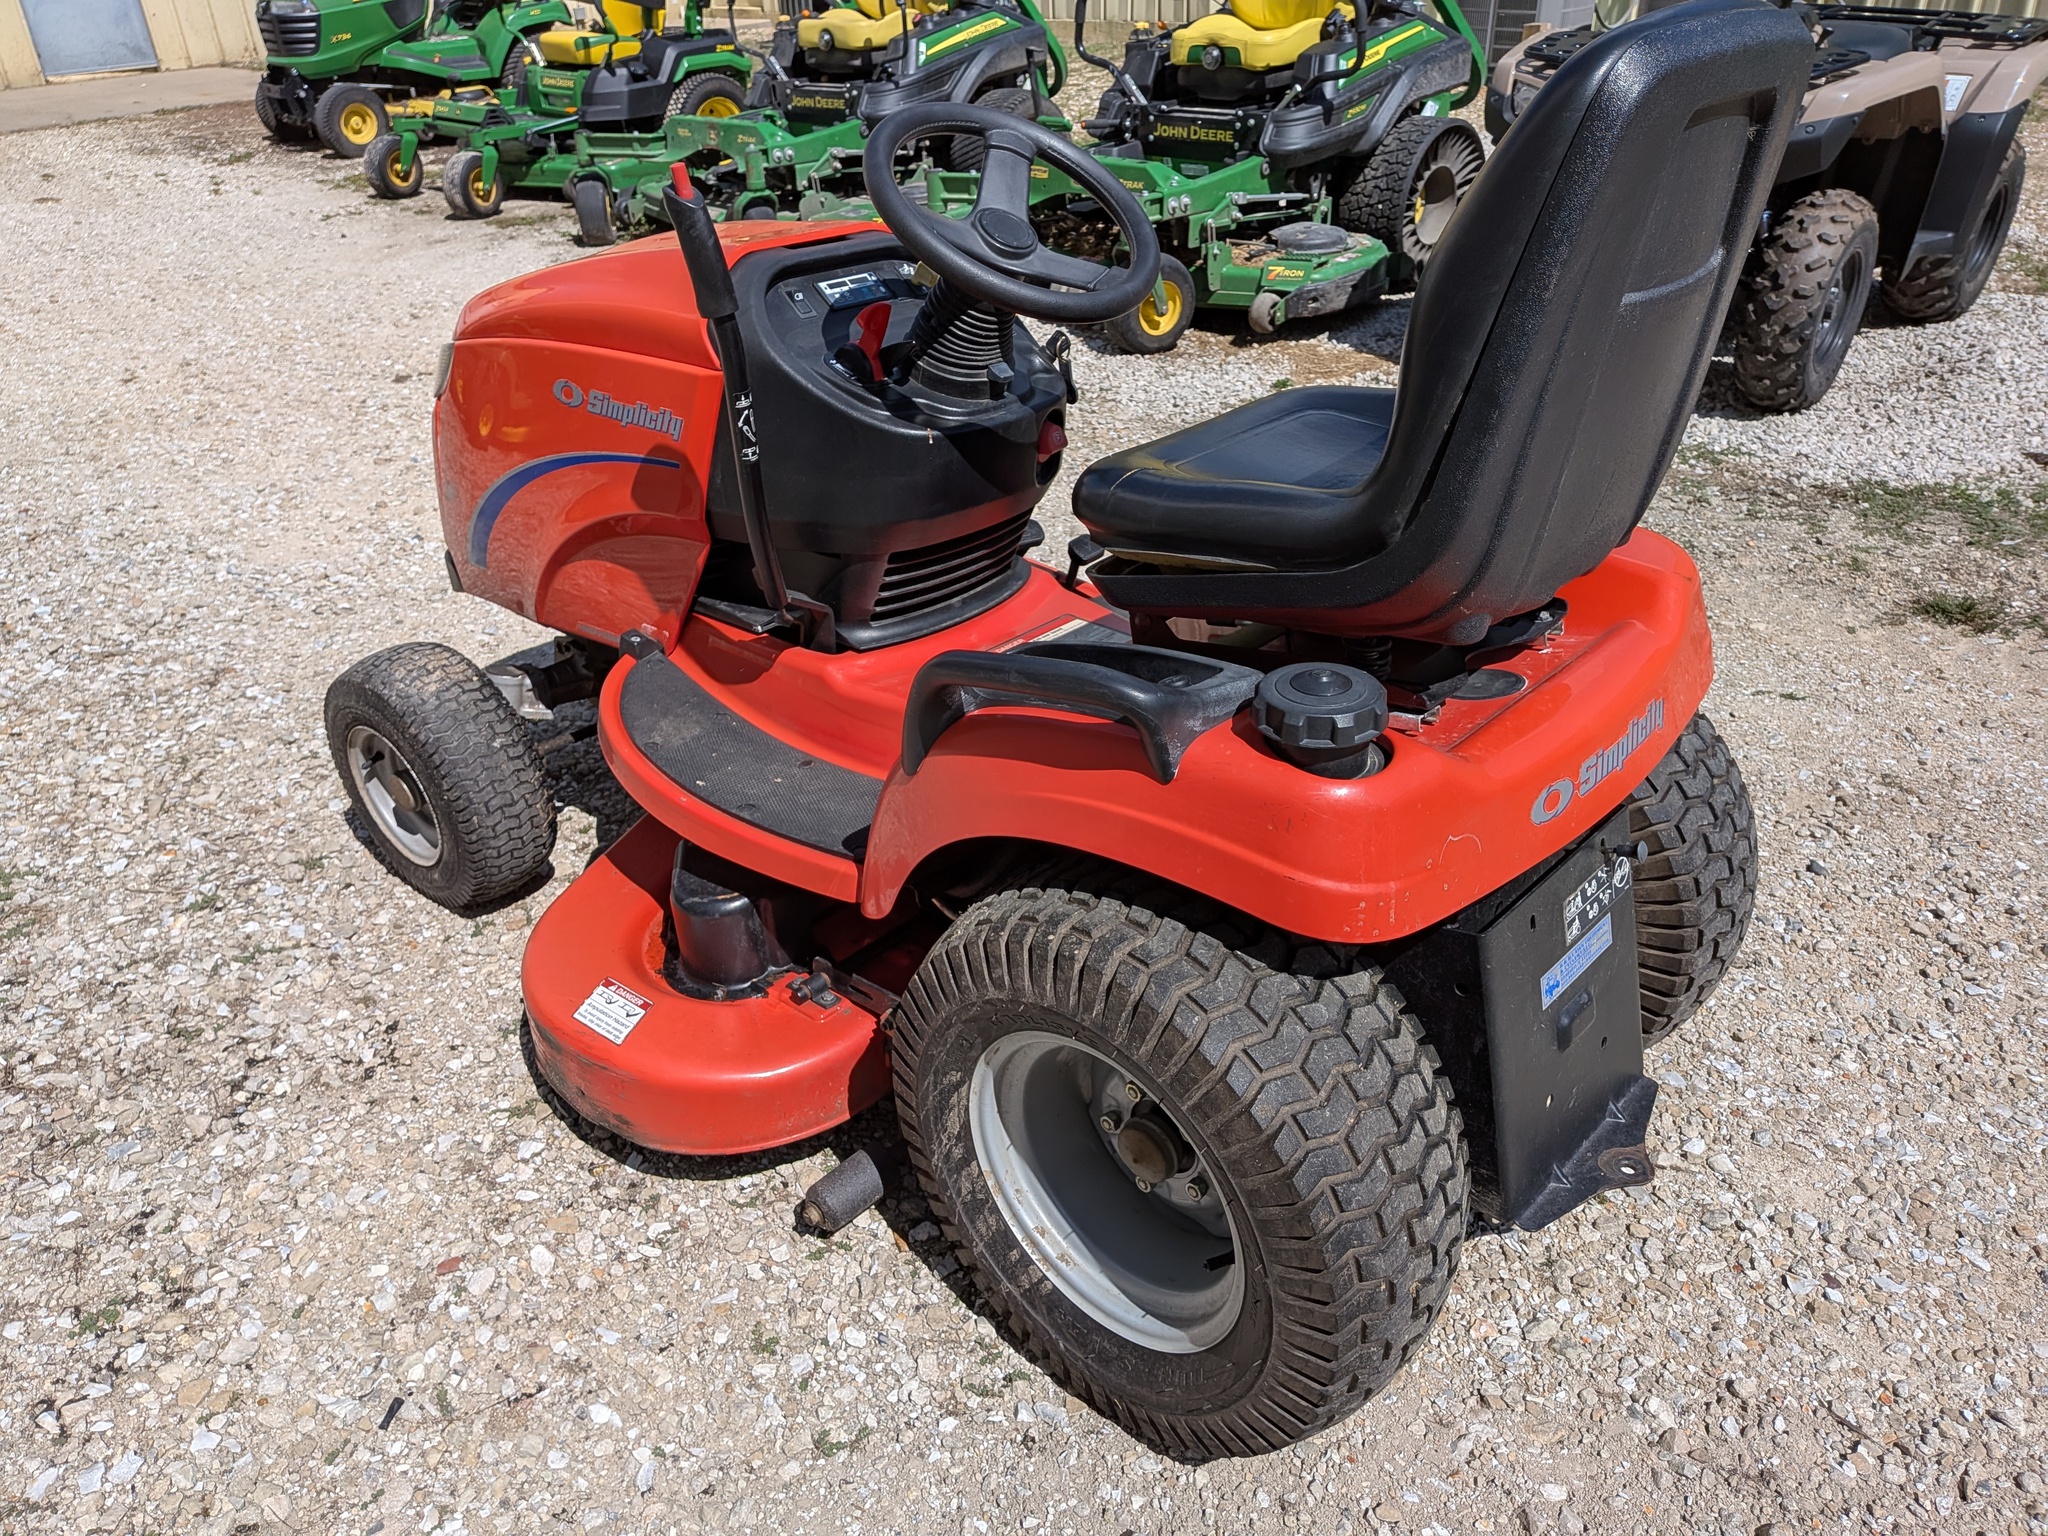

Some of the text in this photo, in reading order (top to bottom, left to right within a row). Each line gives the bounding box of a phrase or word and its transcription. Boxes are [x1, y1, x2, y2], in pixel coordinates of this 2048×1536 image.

[791, 95, 846, 109] JOHN DEERE
[1153, 122, 1235, 142] JOHN DEERE
[586, 388, 684, 443] Simplicity
[1579, 696, 1666, 797] Simplicity
[615, 987, 644, 1006] DANGER
[585, 1001, 630, 1029] Amputation Hazard
